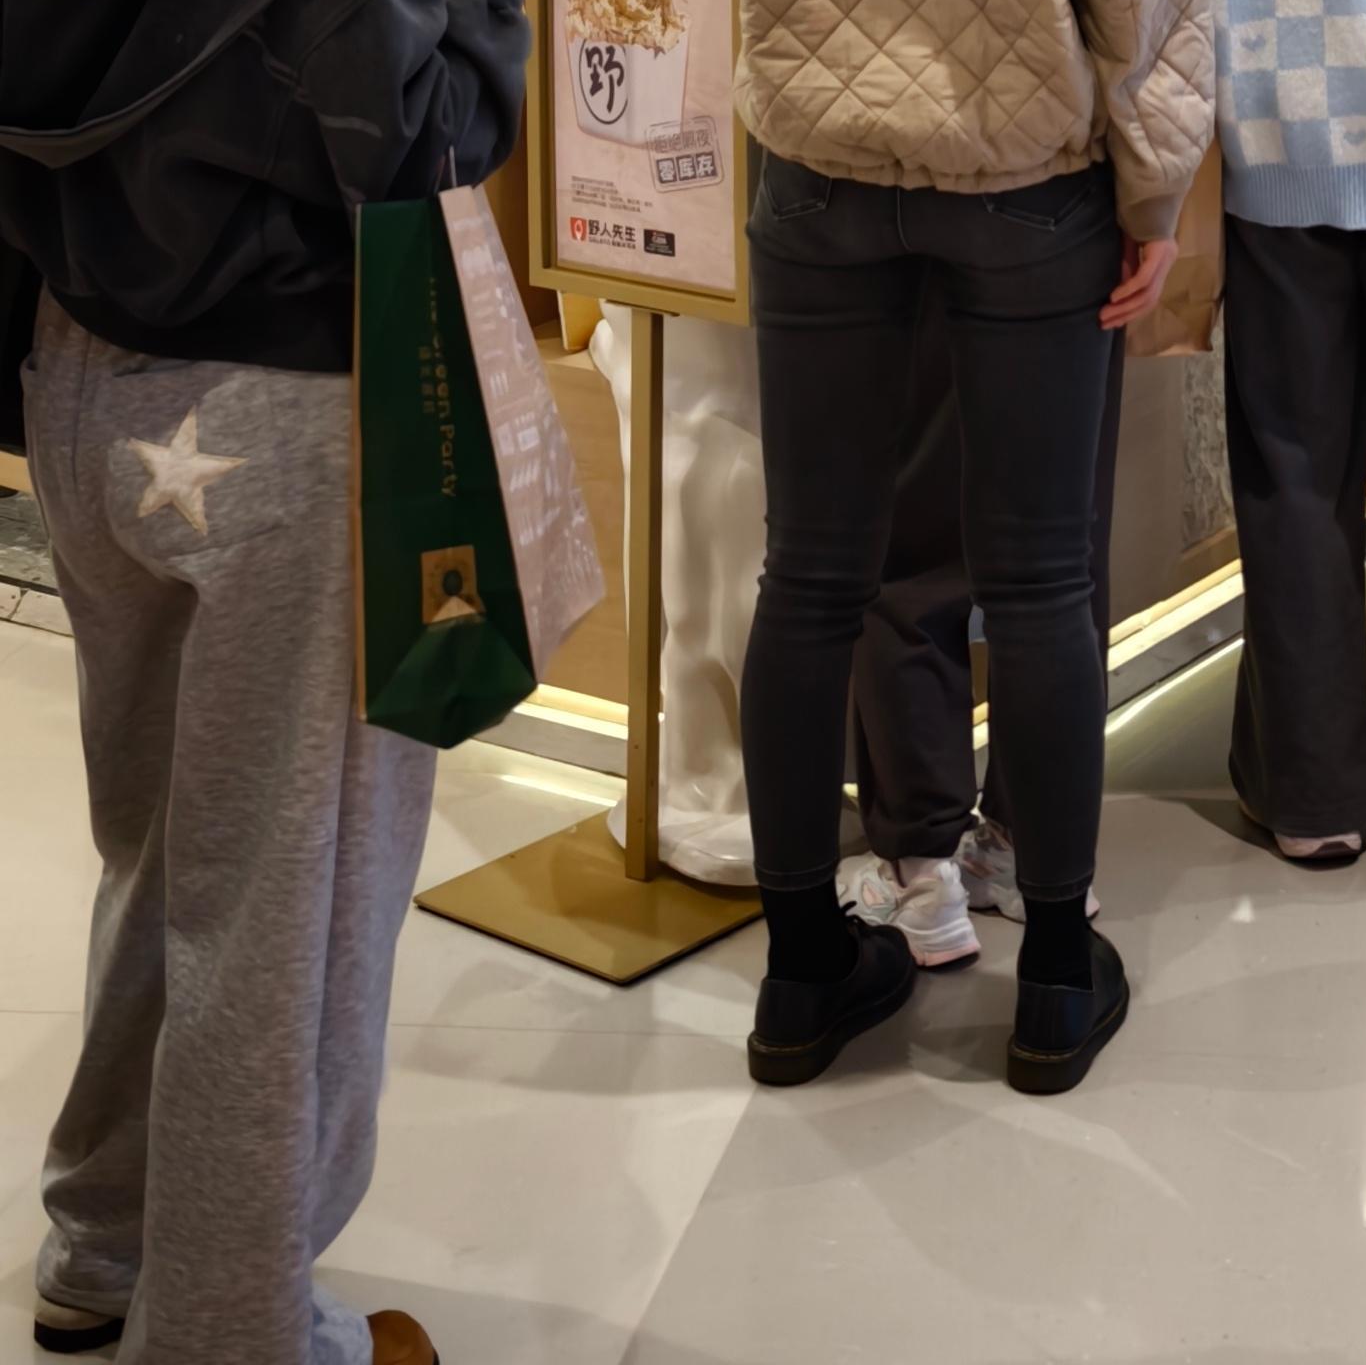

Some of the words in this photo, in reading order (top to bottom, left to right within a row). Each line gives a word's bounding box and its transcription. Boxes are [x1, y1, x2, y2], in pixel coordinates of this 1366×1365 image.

[585, 45, 625, 114] 野
[657, 152, 717, 184] 零库存
[588, 219, 637, 243] 野人先生
[439, 423, 457, 498] Party
